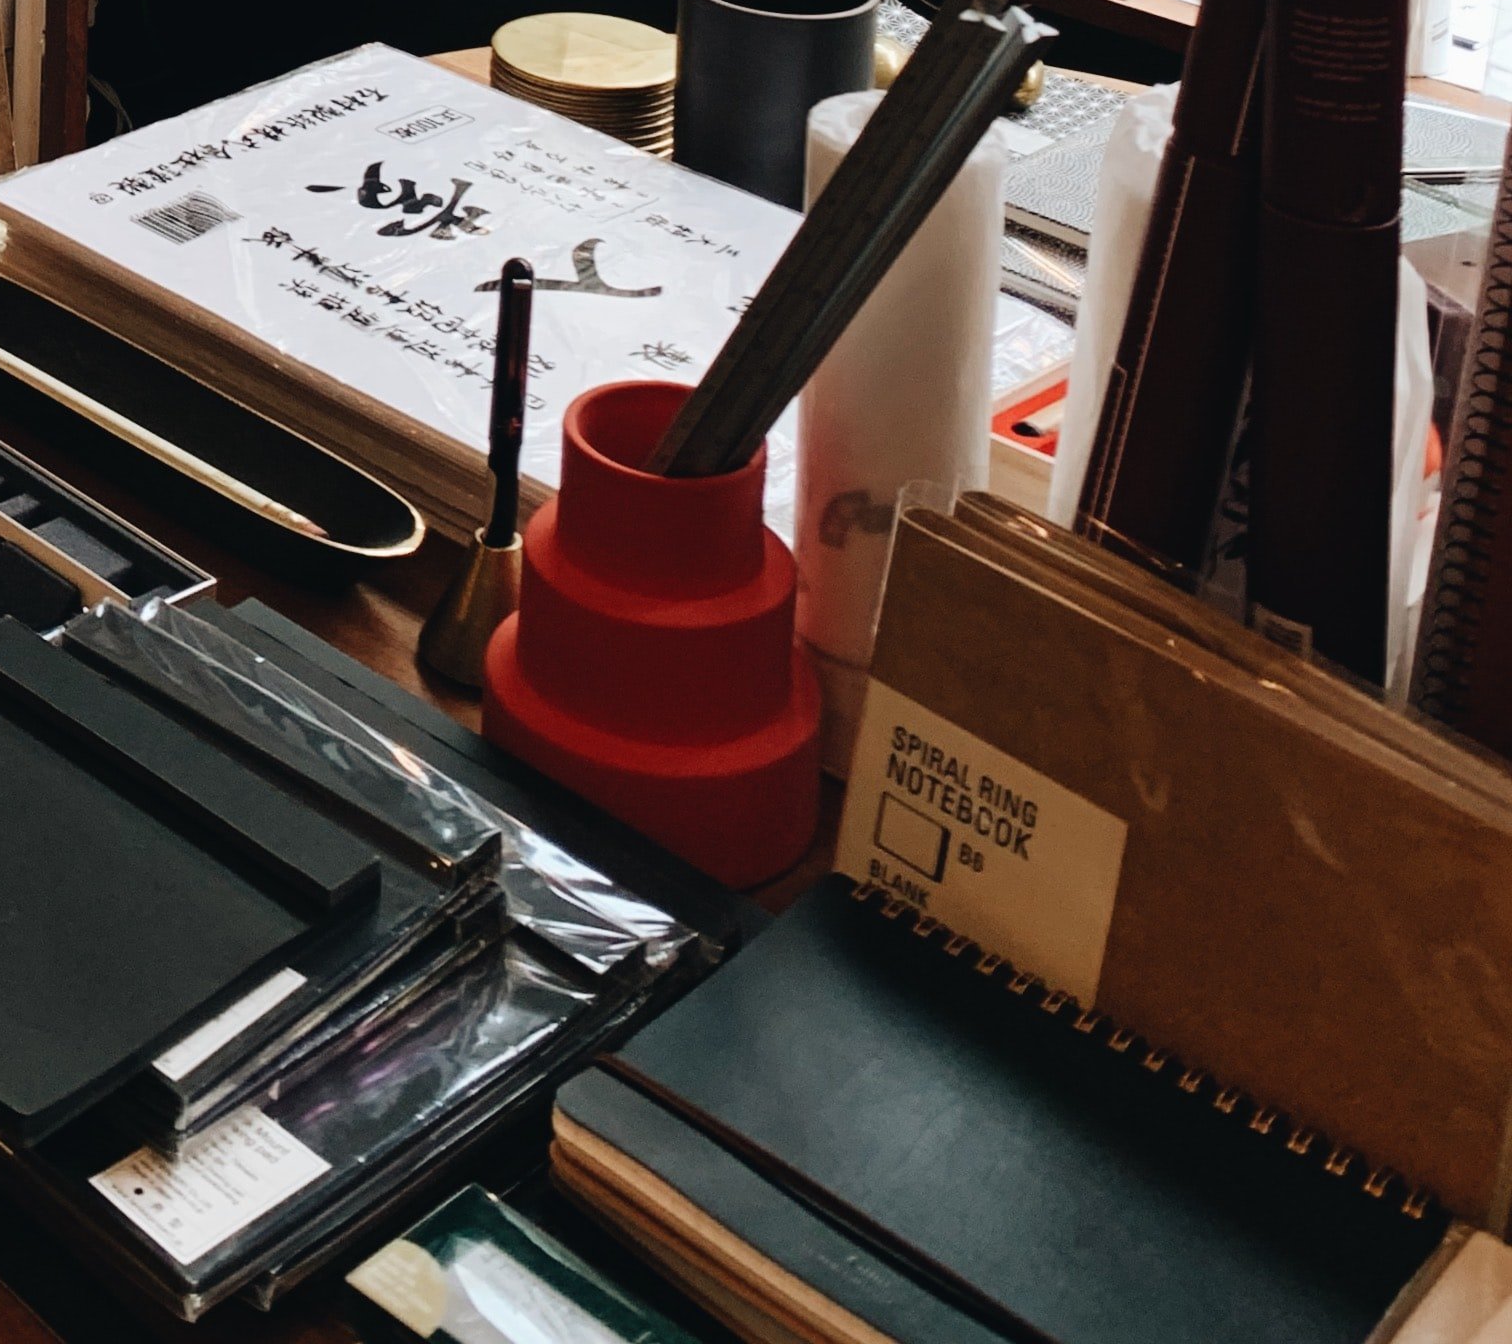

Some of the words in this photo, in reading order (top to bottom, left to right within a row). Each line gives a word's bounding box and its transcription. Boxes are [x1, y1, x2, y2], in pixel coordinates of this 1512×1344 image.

[277, 277, 546, 410] 日書道連盟推奨
[887, 752, 1034, 862] NOTEBOOK
[891, 725, 972, 792] SPIRAL
[978, 775, 1039, 829] RING
[869, 858, 930, 907] BLANK
